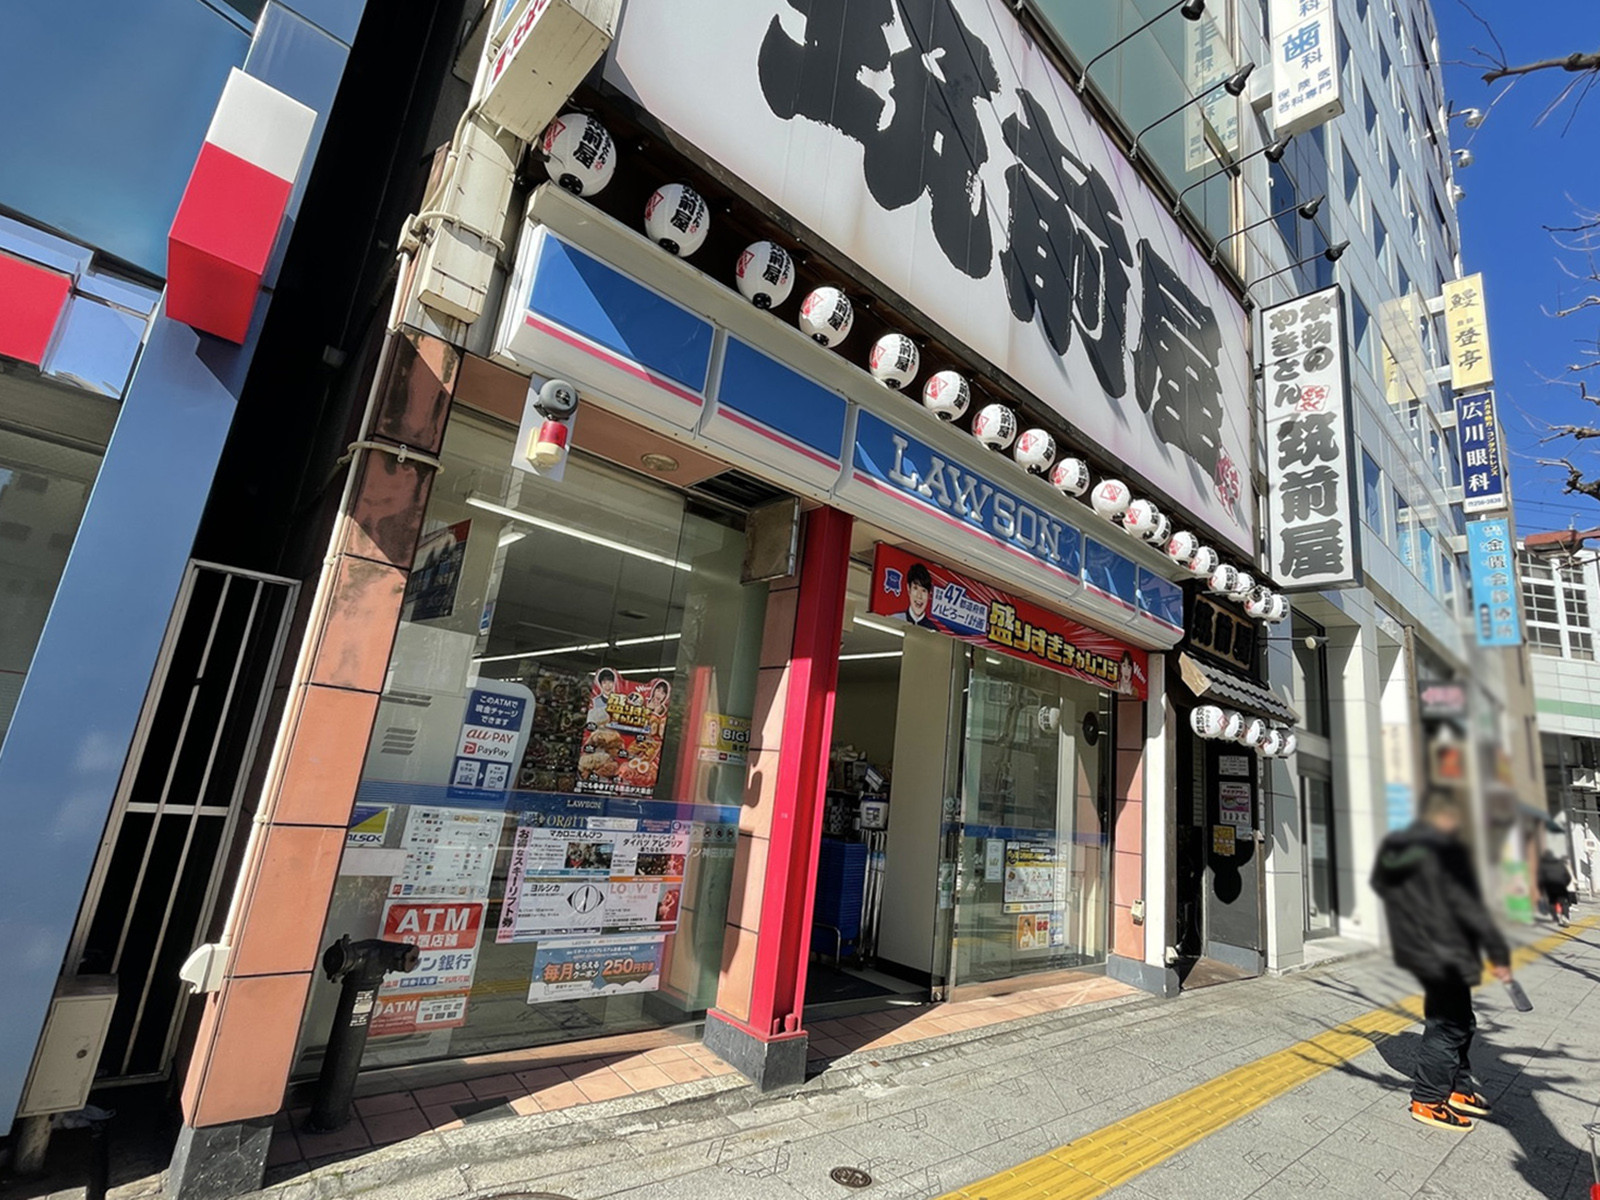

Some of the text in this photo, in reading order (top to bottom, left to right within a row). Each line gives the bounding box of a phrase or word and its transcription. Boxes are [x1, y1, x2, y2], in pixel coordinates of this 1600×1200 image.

[1300, 296, 1334, 373] 本物の
[1455, 327, 1482, 371] 登亭
[1270, 309, 1302, 408] やきとん
[1462, 401, 1491, 493] 広川眼科
[888, 433, 1063, 561] LAWSON
[1278, 411, 1345, 579] 筑前屋
[987, 600, 1120, 683] 盛りすぎチャレンジ
[480, 695, 518, 709] このATMで
[475, 704, 519, 718] 現金チャージ
[481, 715, 509, 726] できます
[466, 729, 514, 744] au PAY
[477, 745, 510, 758] PayPay
[566, 800, 601, 812] LAWSON
[549, 829, 603, 839] マカロニえんぴつ
[500, 829, 530, 928] お得なスキーリフト券
[530, 884, 561, 893] ヨルシカ
[395, 908, 471, 933] ATM
[544, 963, 574, 981] 毎月
[575, 961, 600, 970] もらえる
[573, 968, 599, 979] クーポン
[384, 1001, 416, 1014] ATM
